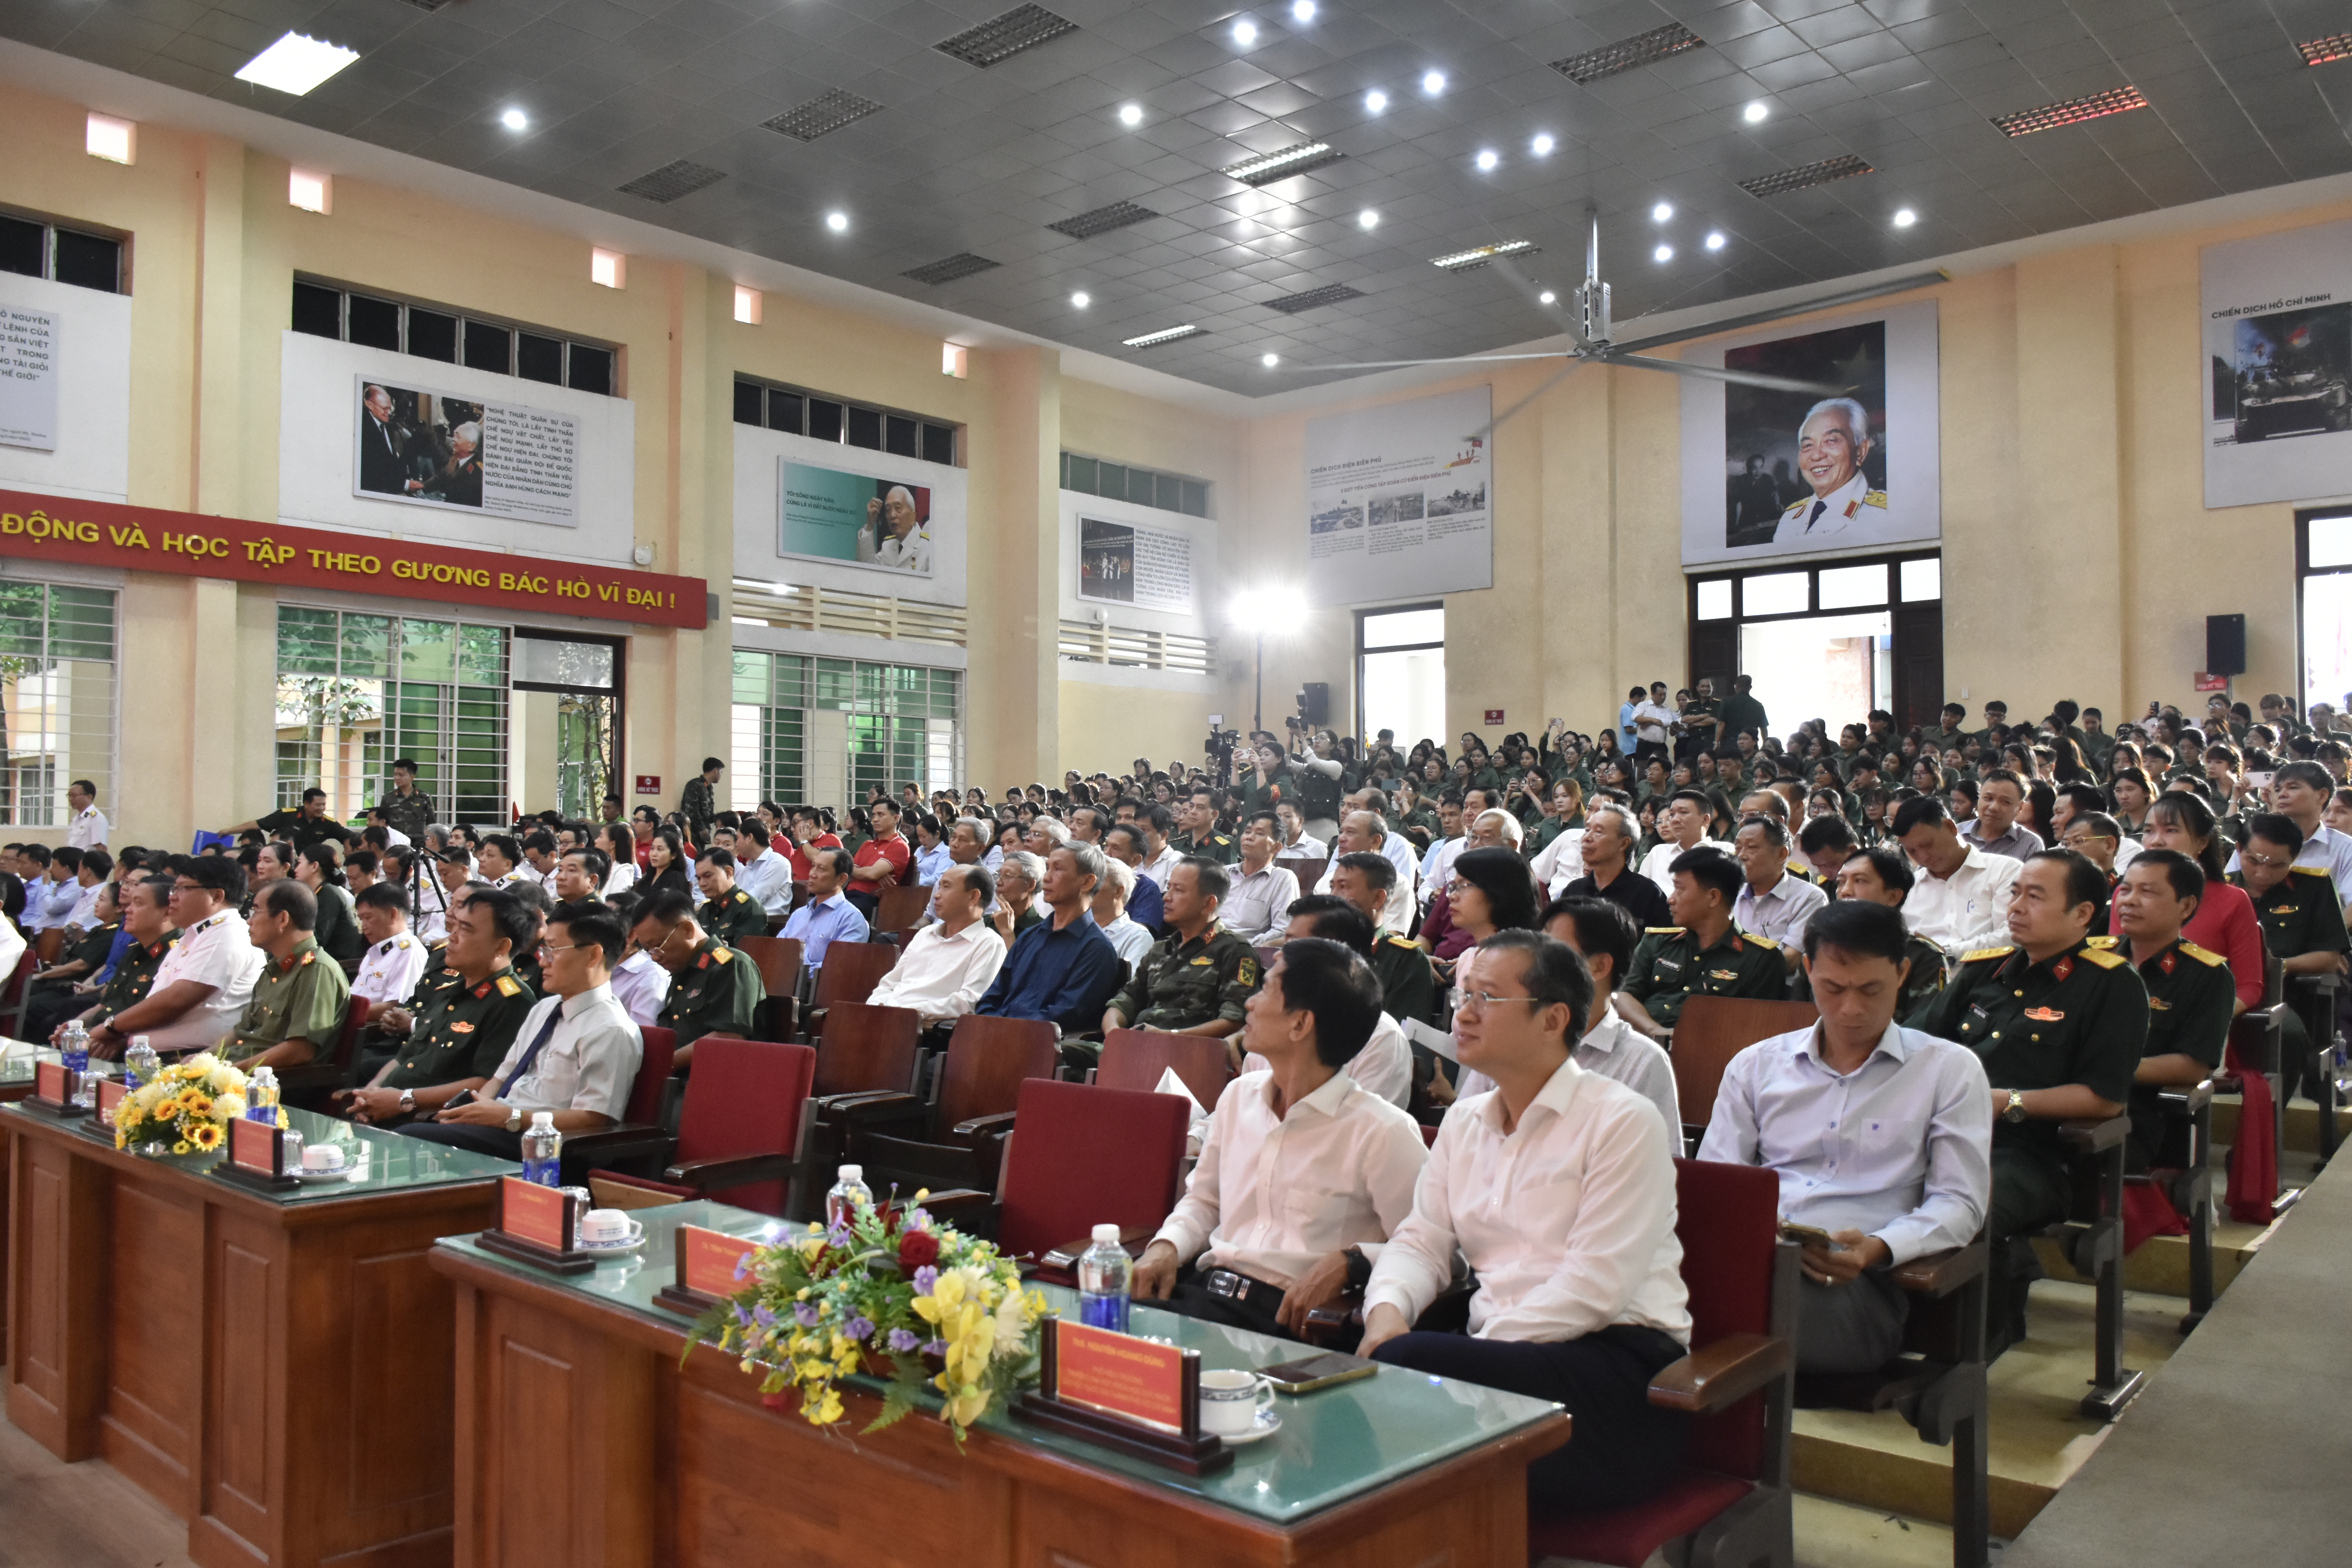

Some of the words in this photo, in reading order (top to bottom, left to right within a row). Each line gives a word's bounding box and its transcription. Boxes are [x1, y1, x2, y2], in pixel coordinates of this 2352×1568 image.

[2212, 306, 2241, 319] CHIẾN
[2243, 304, 2267, 315] DỊCH
[2269, 298, 2283, 310] HỒ
[2286, 295, 2303, 307] CHÍ
[2305, 293, 2331, 304] MINH
[12, 313, 50, 325] NGUYÊN
[4, 323, 27, 333] LỆNH
[30, 328, 49, 337] CỦA
[8, 335, 26, 344] SẢN
[29, 339, 49, 348] VIỆT
[17, 349, 49, 359] TRONG
[0, 368, 14, 377] HẾ
[29, 363, 48, 371] GIỎI
[1, 511, 99, 543] ĐỘNG
[109, 522, 150, 549] VÀ
[163, 532, 229, 560] HỌC
[242, 537, 296, 568] TẬP
[307, 549, 381, 574] THEO
[392, 559, 491, 587] GƯƠNG
[499, 571, 548, 594] BÁC
[557, 575, 591, 599] HỒ
[597, 581, 619, 602] VĨ
[627, 588, 663, 610] ĐẠI
